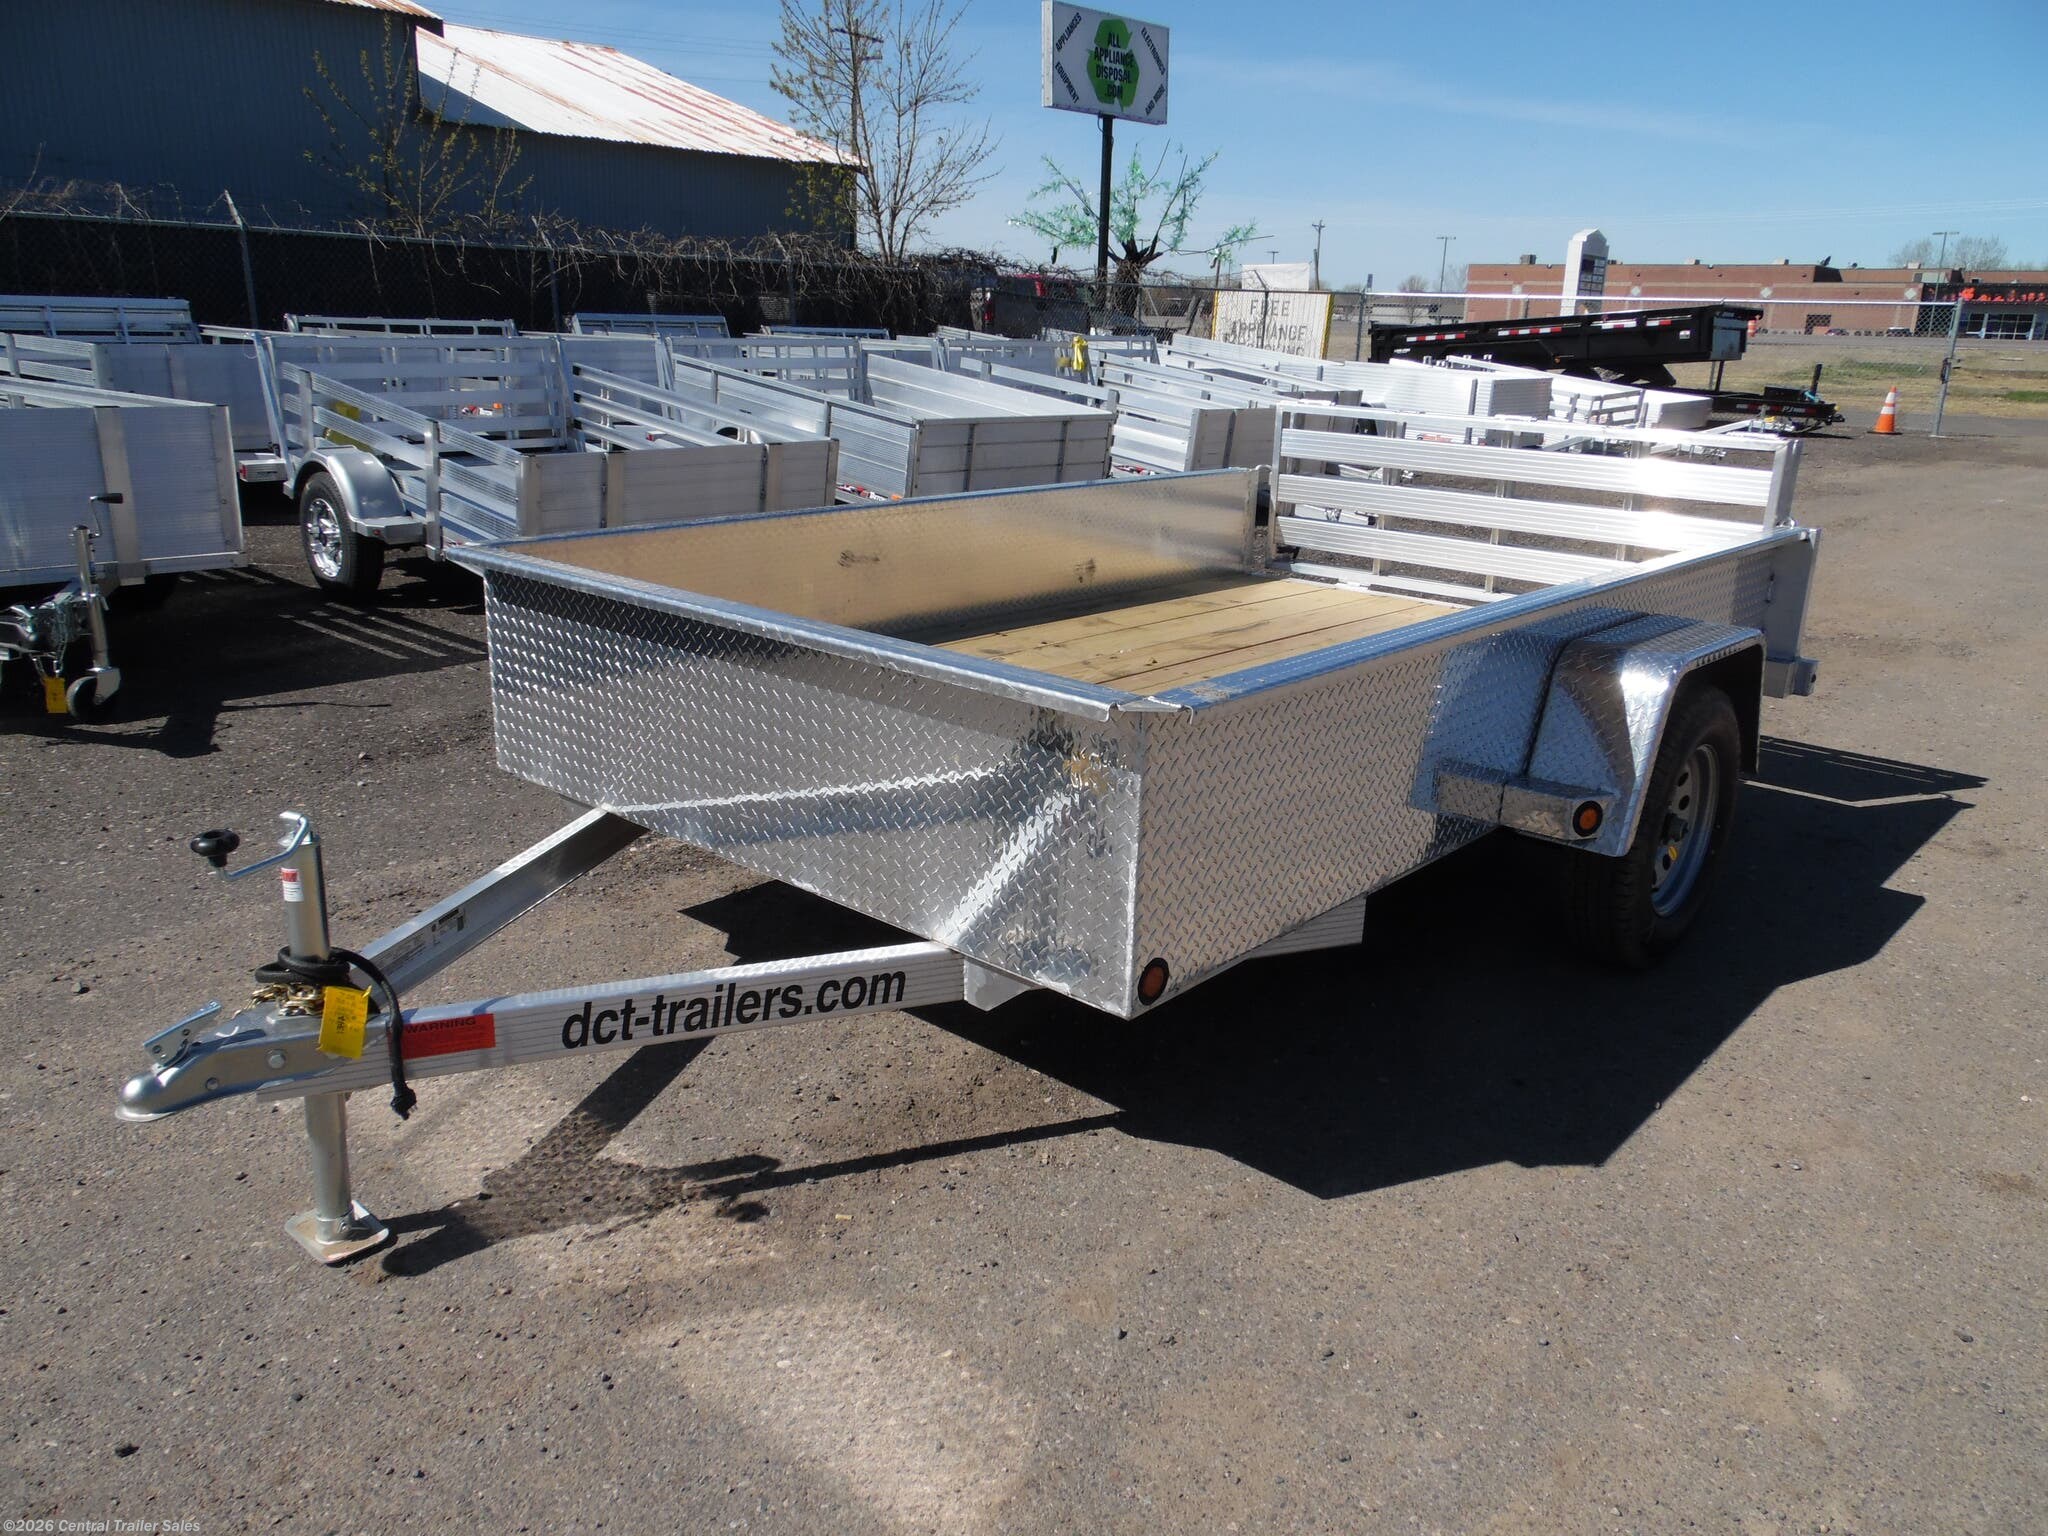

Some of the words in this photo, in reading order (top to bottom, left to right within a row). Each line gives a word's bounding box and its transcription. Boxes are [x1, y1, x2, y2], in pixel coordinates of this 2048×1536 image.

[1055, 12, 1082, 52] APPLIANCES
[1107, 32, 1121, 48] ALL
[1094, 46, 1134, 68] APPLIANCE
[1141, 27, 1166, 76] ELECTRONICS
[1055, 62, 1080, 104] EQUIPMENT
[1095, 63, 1132, 84] DISPOSAL
[1145, 99, 1155, 116] AND
[561, 970, 906, 1049] dct-trailers.com
[406, 1017, 477, 1034] WARNING
